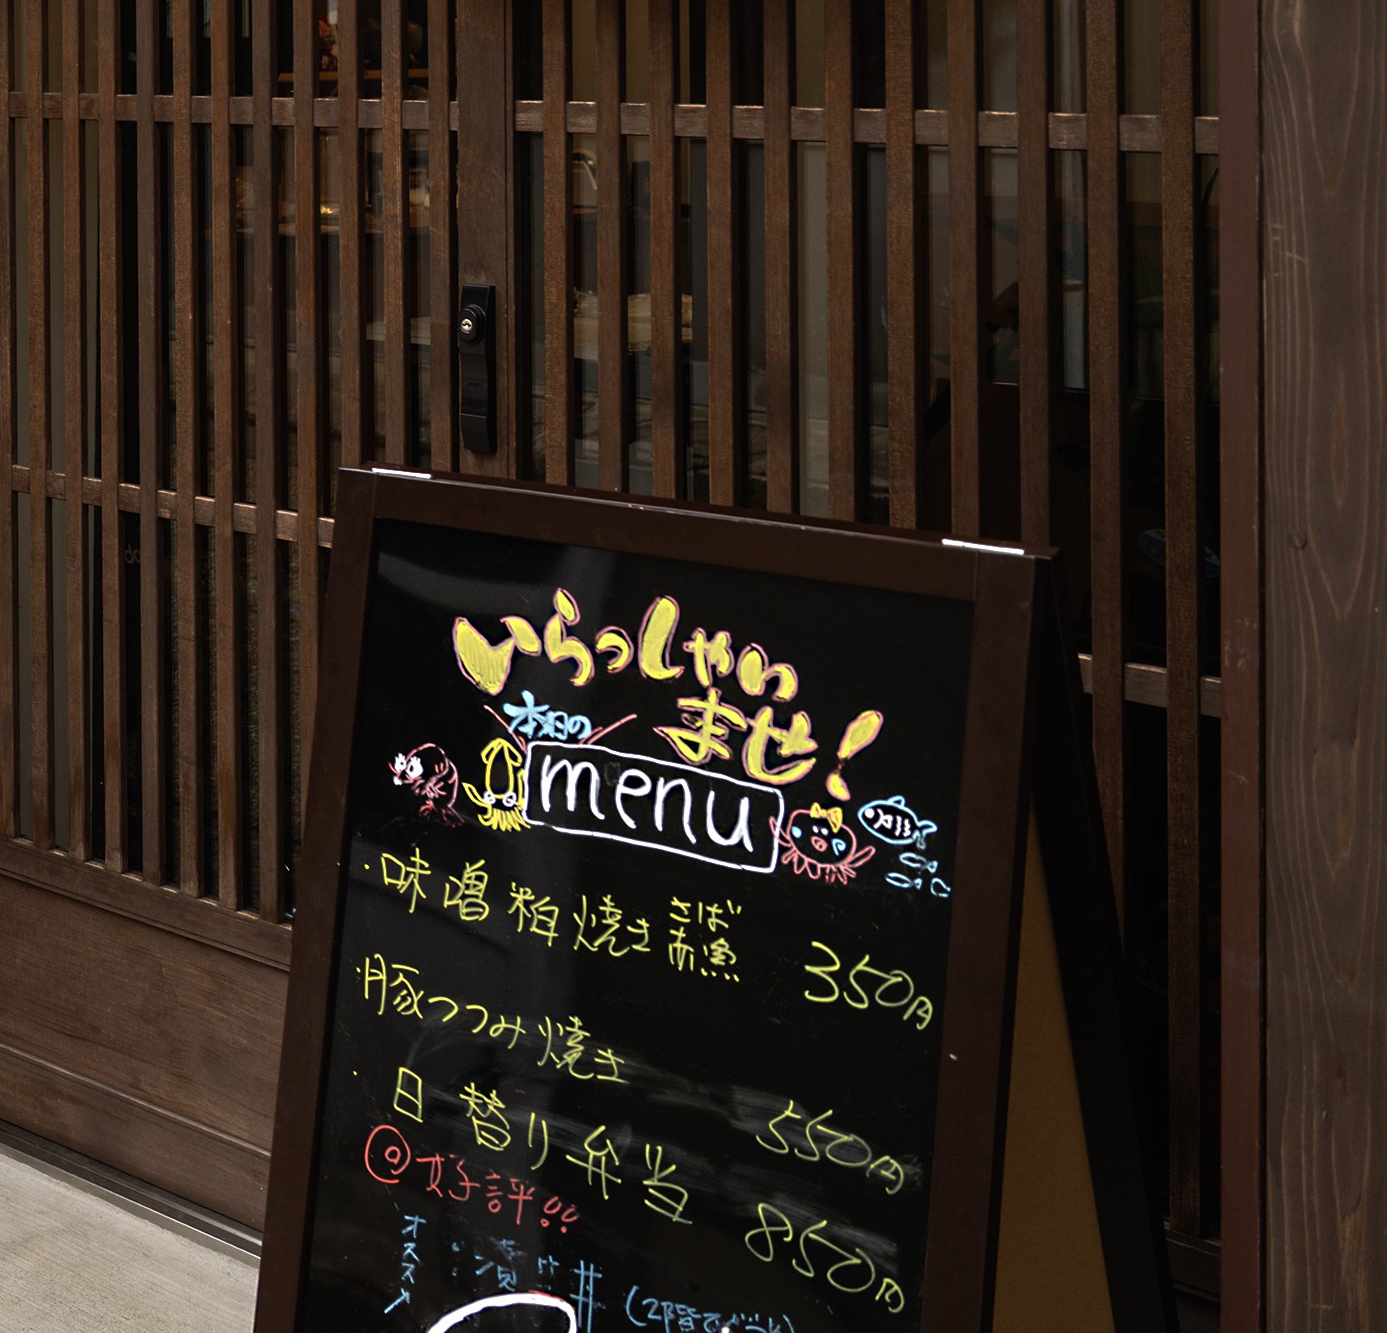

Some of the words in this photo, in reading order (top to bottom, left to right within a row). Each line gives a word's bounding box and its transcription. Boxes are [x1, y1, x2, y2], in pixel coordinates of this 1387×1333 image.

[453, 588, 798, 701] いらっしゃい
[503, 690, 592, 740] 本日の
[653, 689, 883, 800] ませ!
[541, 754, 754, 851] menu
[363, 954, 628, 1084] 豚つつみ焼き
[805, 942, 933, 1029] 350円
[394, 1066, 693, 1224] 日替り弁当
[756, 1100, 904, 1194] 550円
[384, 1215, 427, 1314] オススメ
[745, 1203, 904, 1313] 850円
